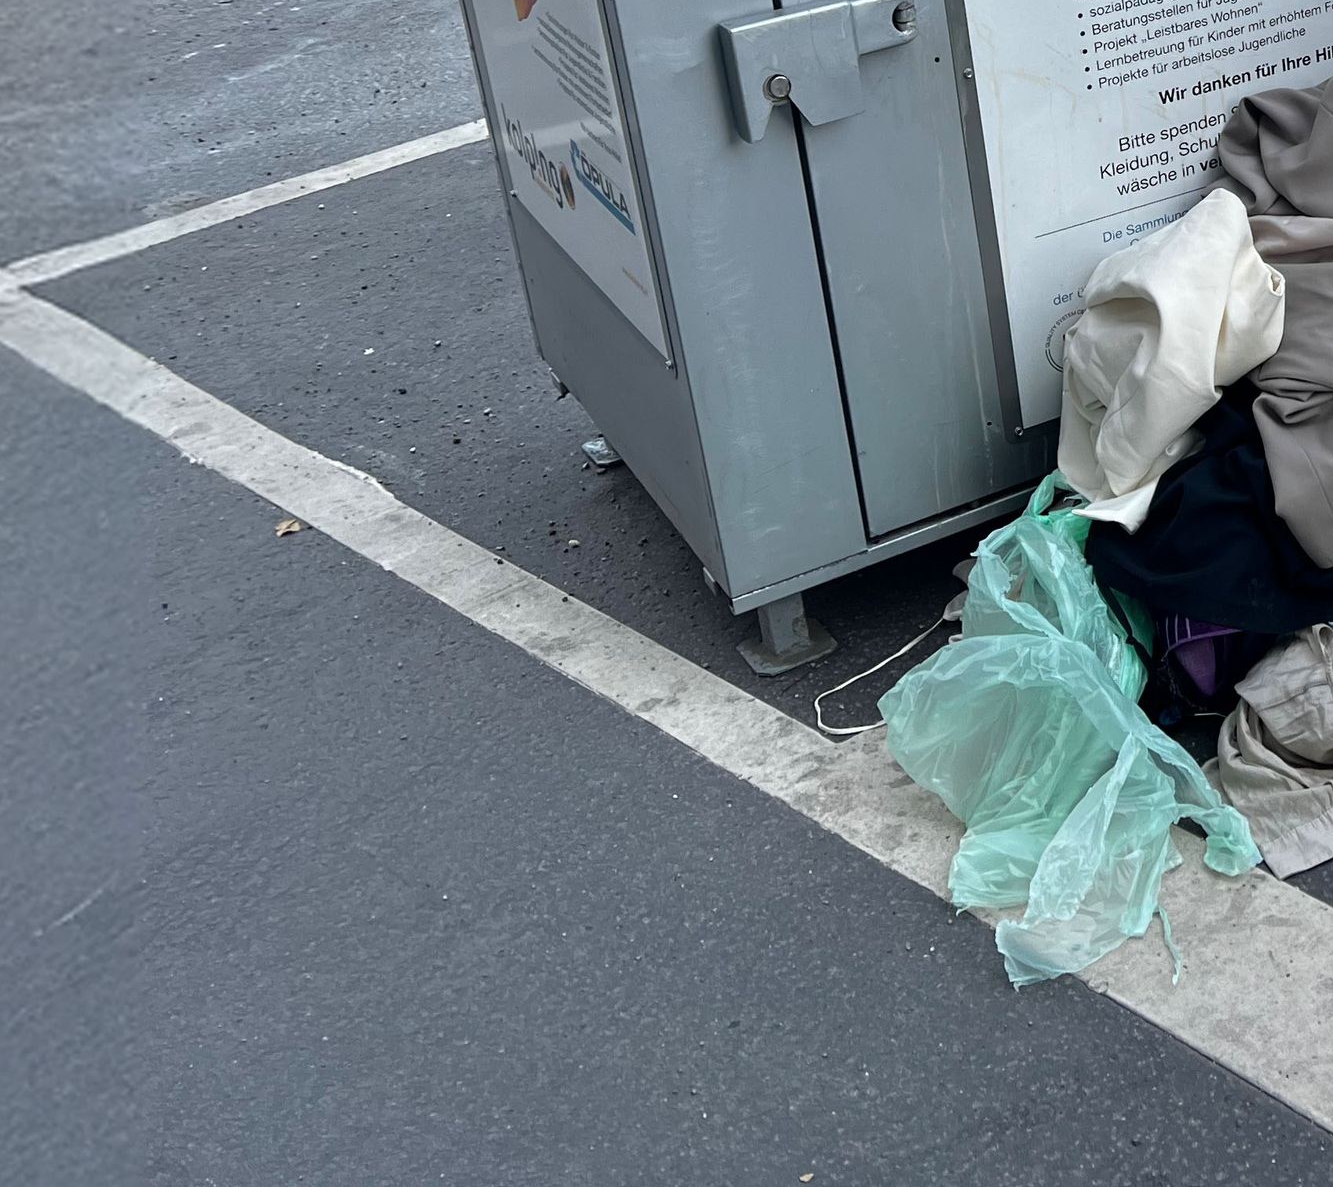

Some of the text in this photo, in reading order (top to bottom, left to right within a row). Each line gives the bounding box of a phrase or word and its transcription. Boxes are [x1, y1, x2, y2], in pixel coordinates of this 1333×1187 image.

[1091, 3, 1194, 36] Beratungsstellen
[1093, 33, 1138, 54] Projekt
[1141, 17, 1208, 44] „Leistbares
[1096, 40, 1185, 71] Lernbetreuung
[1187, 36, 1204, 48] für
[1207, 25, 1245, 43] Kinder
[1248, 19, 1266, 33] mit
[1269, 5, 1322, 28] erhöhtem
[1098, 27, 1306, 89] Projekte für arbeitslose Jugendliche
[1158, 87, 1188, 105] Wir
[1192, 71, 1251, 97] danken
[1255, 62, 1278, 79] für
[1281, 54, 1311, 72] Ihre
[1118, 112, 1227, 152] Bitte spenden
[1099, 133, 1221, 180] Kleidung, Schu
[580, 150, 632, 220] ÖPULA
[1116, 169, 1177, 196] wäsche
[1182, 163, 1195, 178] in
[1102, 229, 1123, 243] Die
[1053, 291, 1074, 306] der
